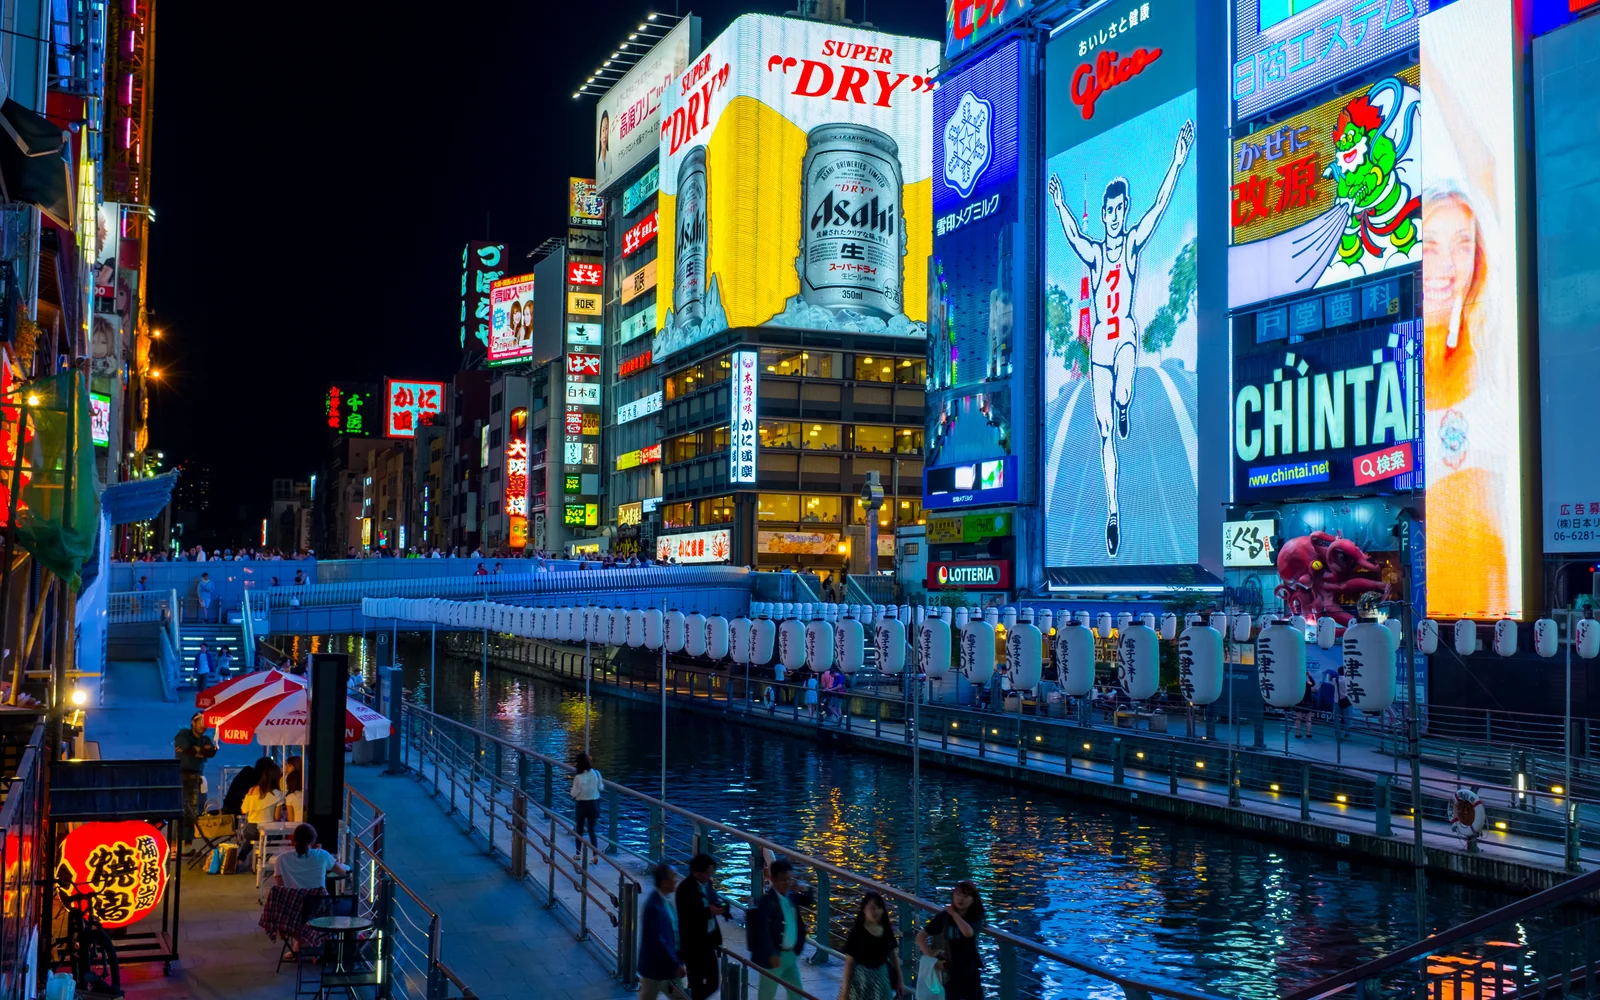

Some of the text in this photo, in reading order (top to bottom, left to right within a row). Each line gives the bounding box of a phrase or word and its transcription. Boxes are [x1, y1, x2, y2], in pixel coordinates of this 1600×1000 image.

[1078, 2, 1150, 57] おいしさと健康
[821, 39, 893, 65] SUPER
[1233, 0, 1416, 100] 日商エステム
[680, 52, 712, 97] SUPER
[1072, 48, 1162, 120] Glico
[1237, 126, 1311, 172] かぜに
[1230, 152, 1319, 228] 改源
[572, 216, 582, 225] 9F
[810, 190, 894, 237] Asahi
[936, 194, 1000, 237] 雪印メグミルク
[829, 263, 878, 275] スーパードライ
[840, 243, 866, 261] 生
[576, 298, 595, 309] 和民
[841, 289, 864, 300] 350ml
[1105, 264, 1122, 340] グリコ
[393, 386, 438, 410] かに
[568, 385, 597, 399] 白木屋
[743, 372, 753, 415] 本場の味
[741, 419, 753, 478] かに道楽
[1376, 449, 1406, 474] 検索
[678, 538, 705, 558] かに道楽
[1232, 526, 1264, 560] くくる
[949, 567, 994, 582] LOTTERIA
[1012, 634, 1021, 675] 電子マネー
[1125, 638, 1136, 683] 電子マネー
[1258, 637, 1276, 700] 三津寺
[1343, 638, 1367, 704] 三津寺
[224, 729, 249, 741] KIRIN
[265, 718, 308, 726] KIRIN
[358, 712, 384, 723] KIRIN
